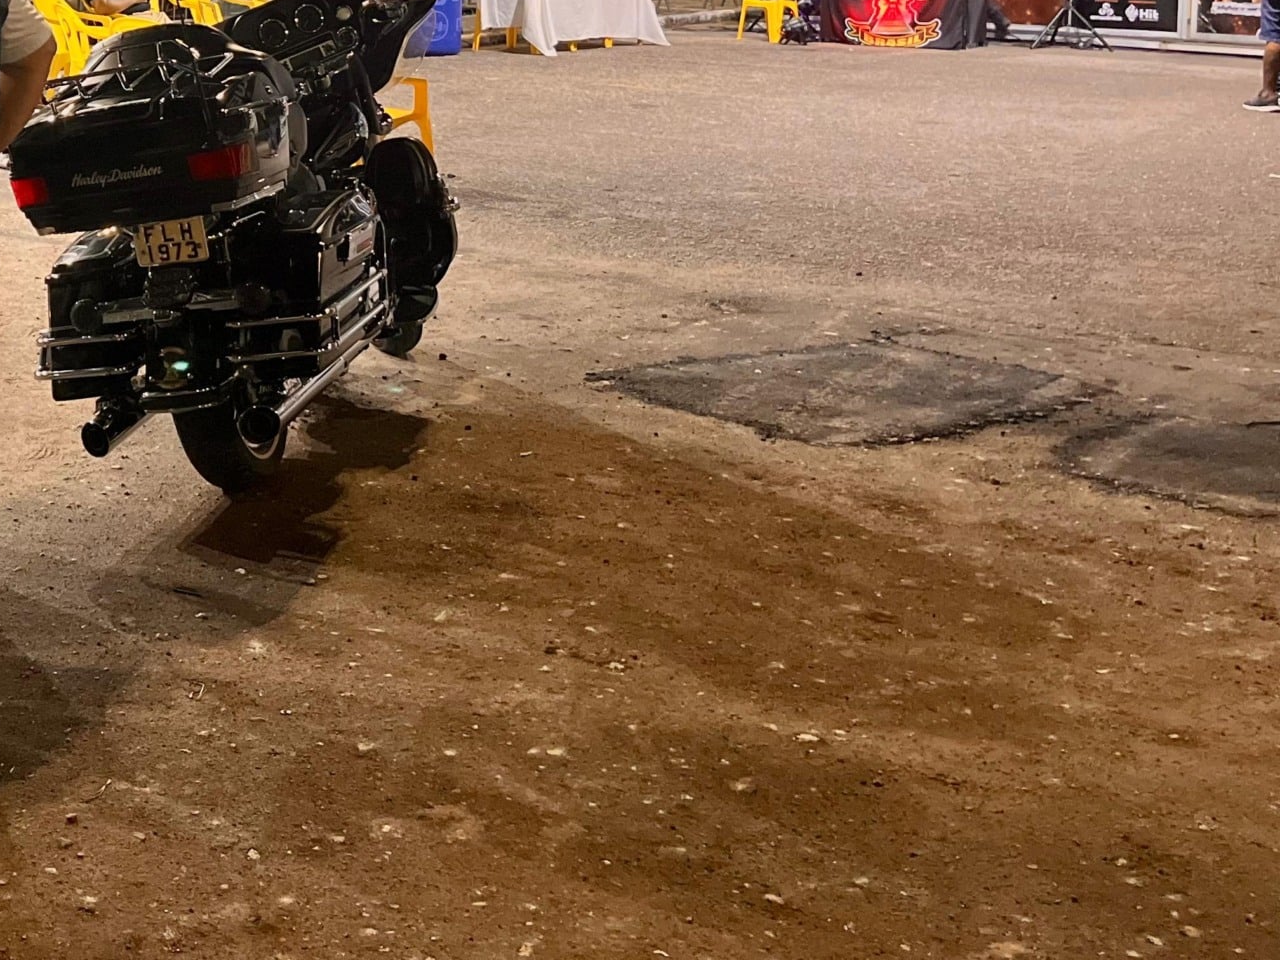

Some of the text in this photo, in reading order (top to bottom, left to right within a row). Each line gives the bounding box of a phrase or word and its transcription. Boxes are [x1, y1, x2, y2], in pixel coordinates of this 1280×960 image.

[71, 163, 163, 188] Harley-Davidson
[143, 221, 193, 244] FLH
[147, 241, 200, 264] 1973
